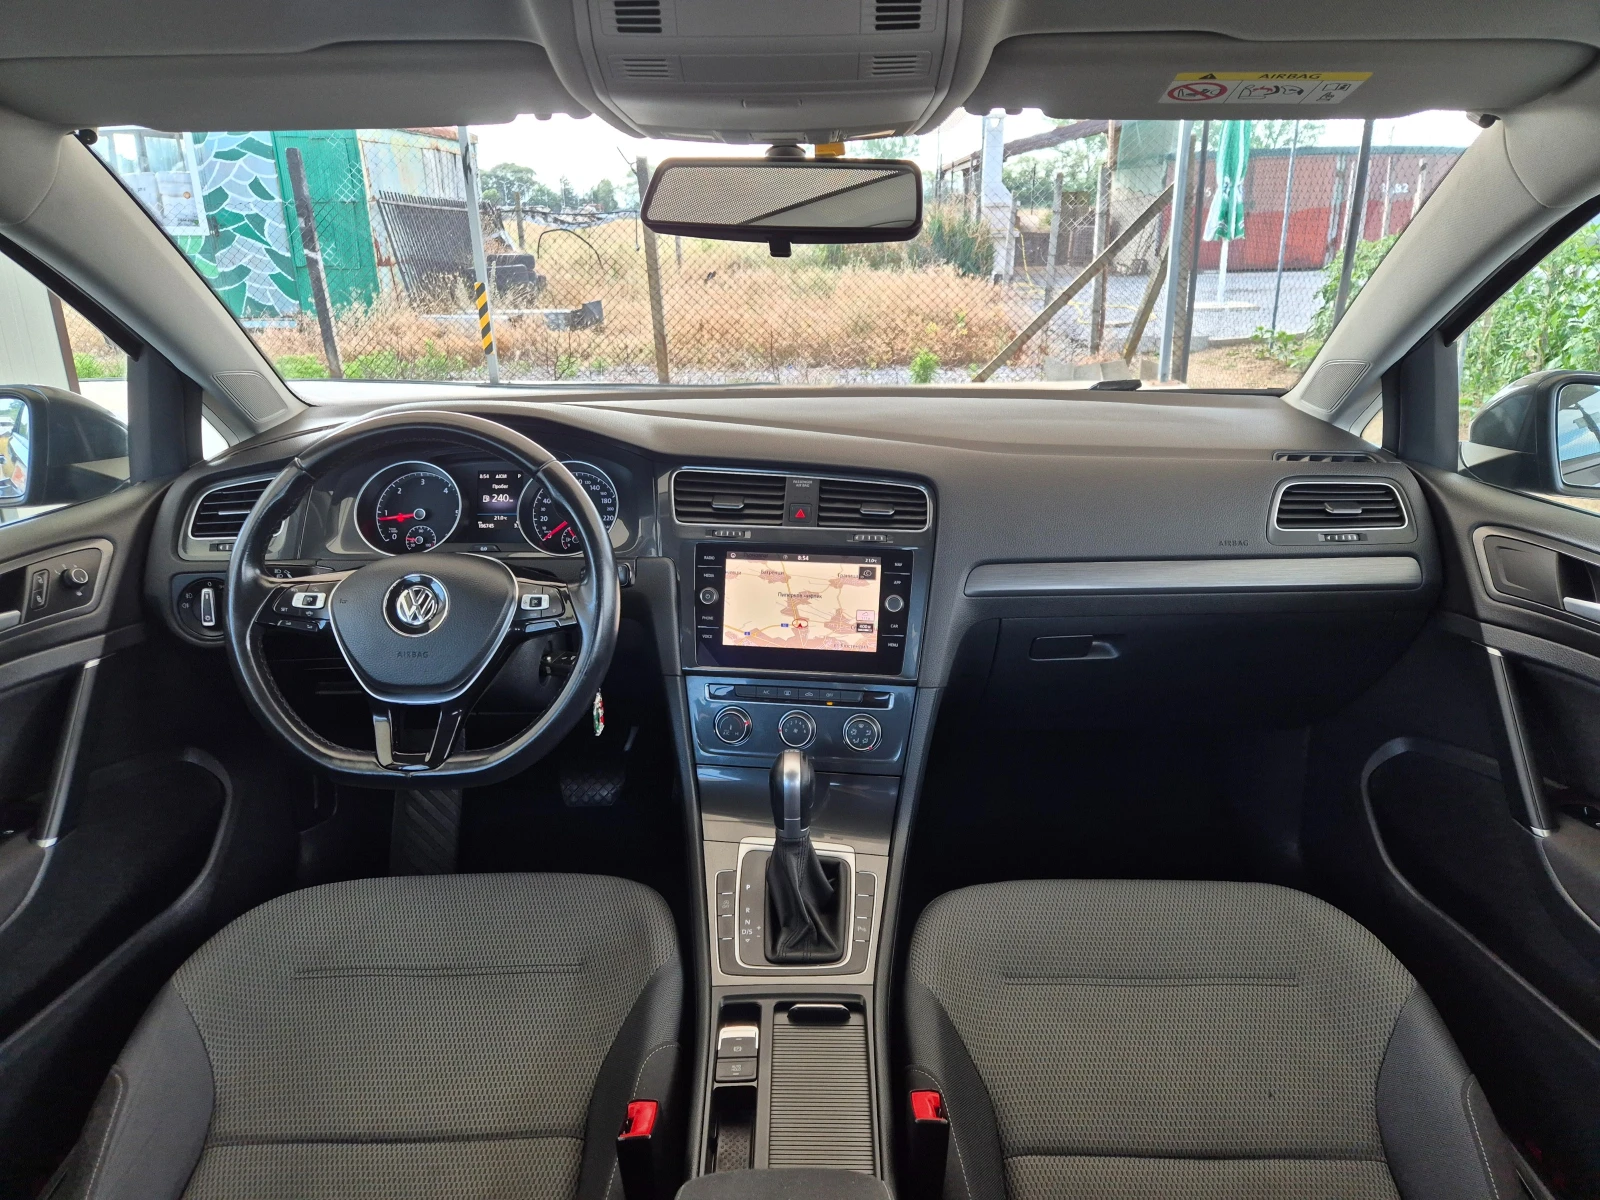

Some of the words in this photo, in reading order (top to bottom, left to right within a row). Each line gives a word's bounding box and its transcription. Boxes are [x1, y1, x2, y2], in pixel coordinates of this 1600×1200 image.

[491, 493, 510, 503] 240
[1218, 539, 1249, 547] AIRBAG
[397, 651, 429, 659] AIRBAG
